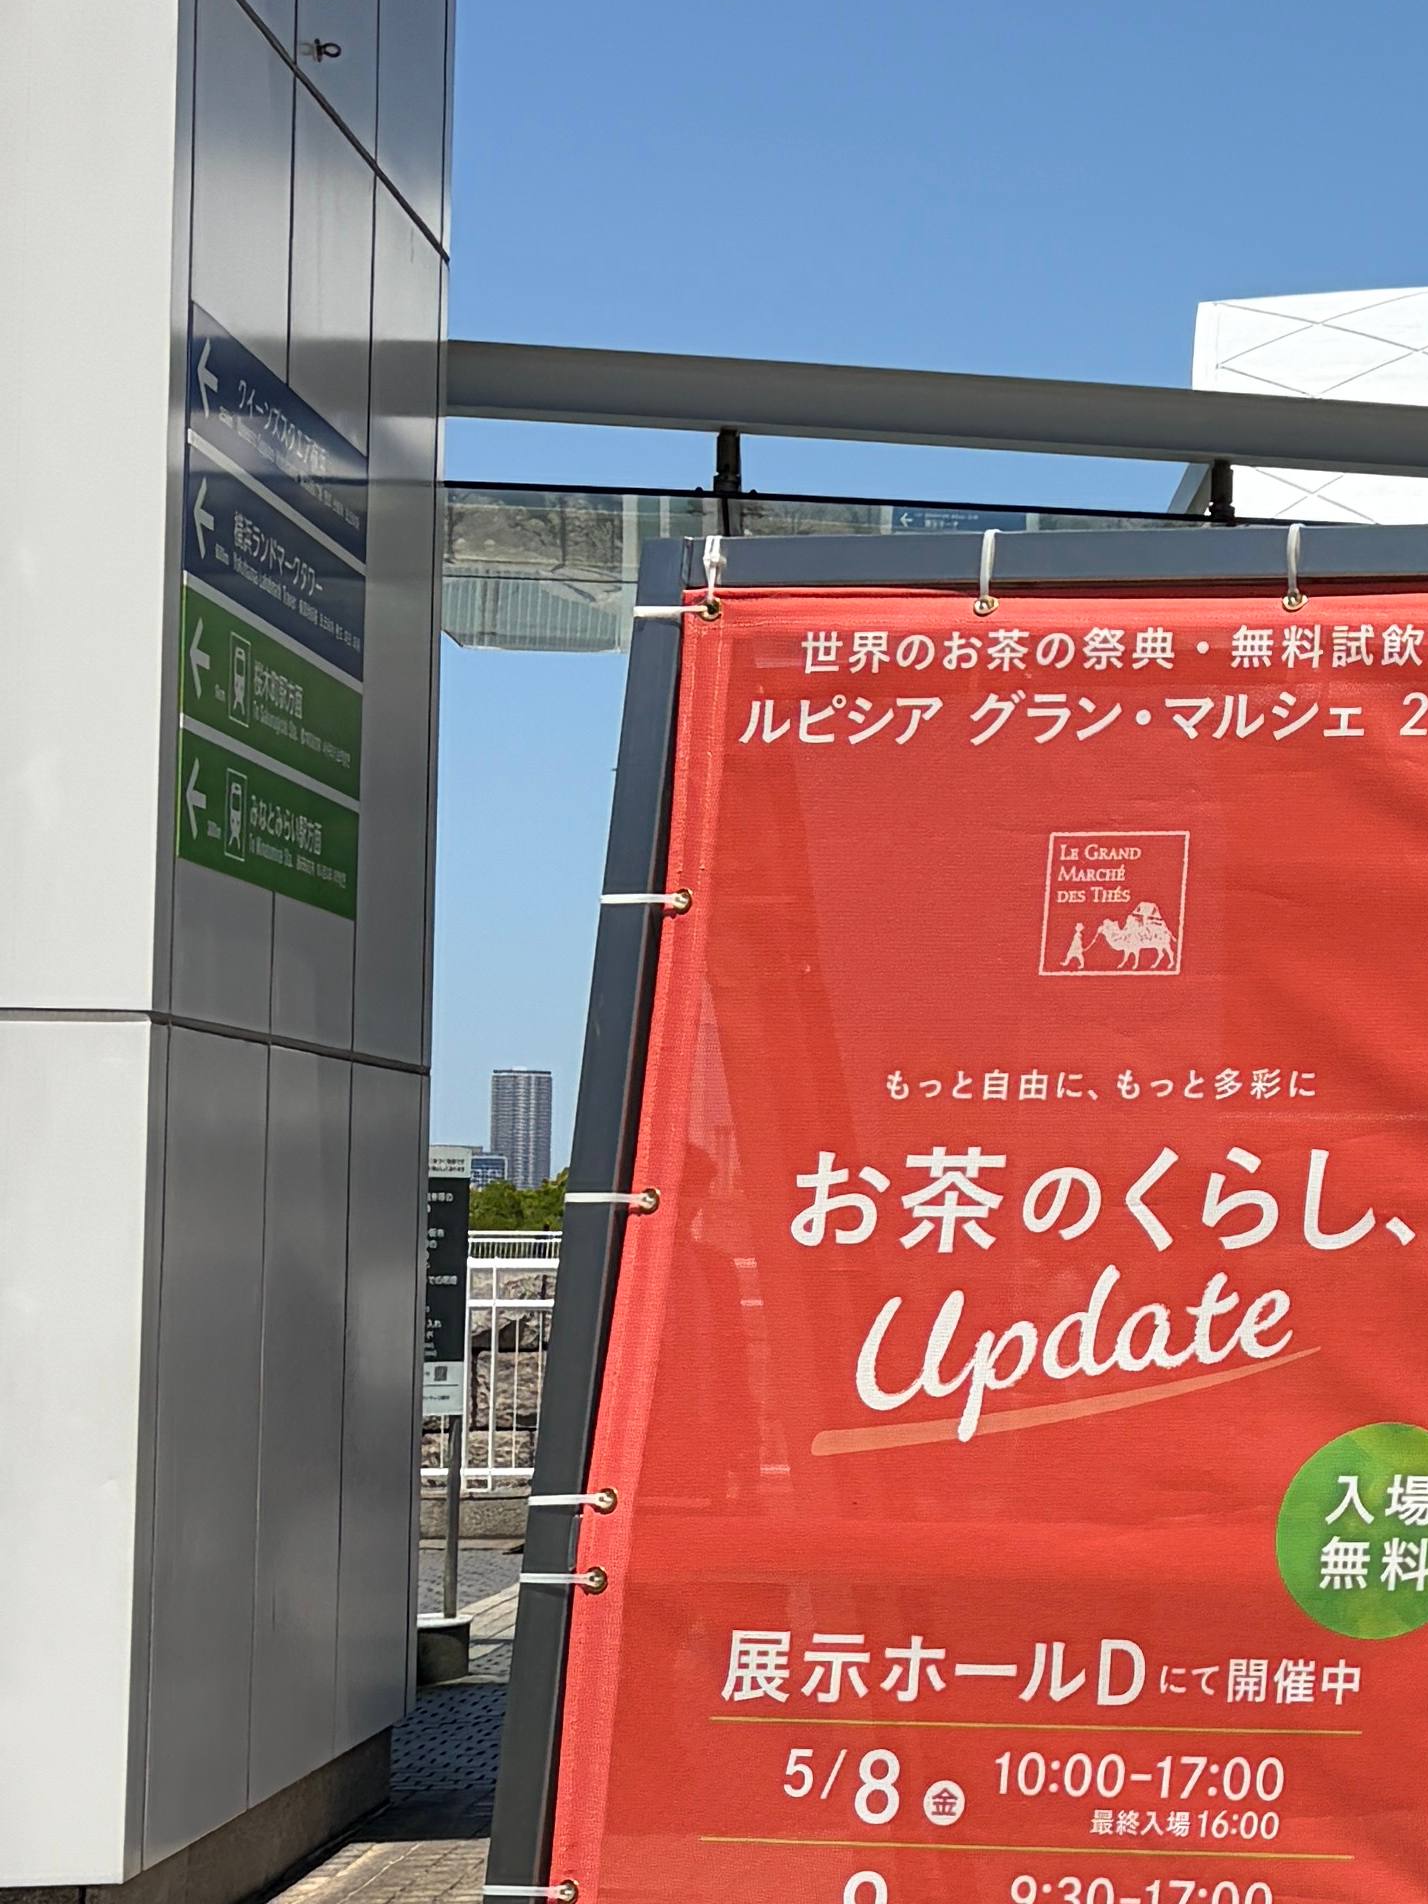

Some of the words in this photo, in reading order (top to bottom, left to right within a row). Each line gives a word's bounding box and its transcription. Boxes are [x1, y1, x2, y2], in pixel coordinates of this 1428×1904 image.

[739, 695, 941, 746] ルピシア
[970, 692, 1366, 743] グラン・マルシェ
[885, 1069, 1317, 1101] もっと自由に、もっと多彩に
[789, 1146, 1417, 1255] お茶のくらし、
[855, 1265, 1293, 1442] Update
[782, 1748, 901, 1824] 5/8
